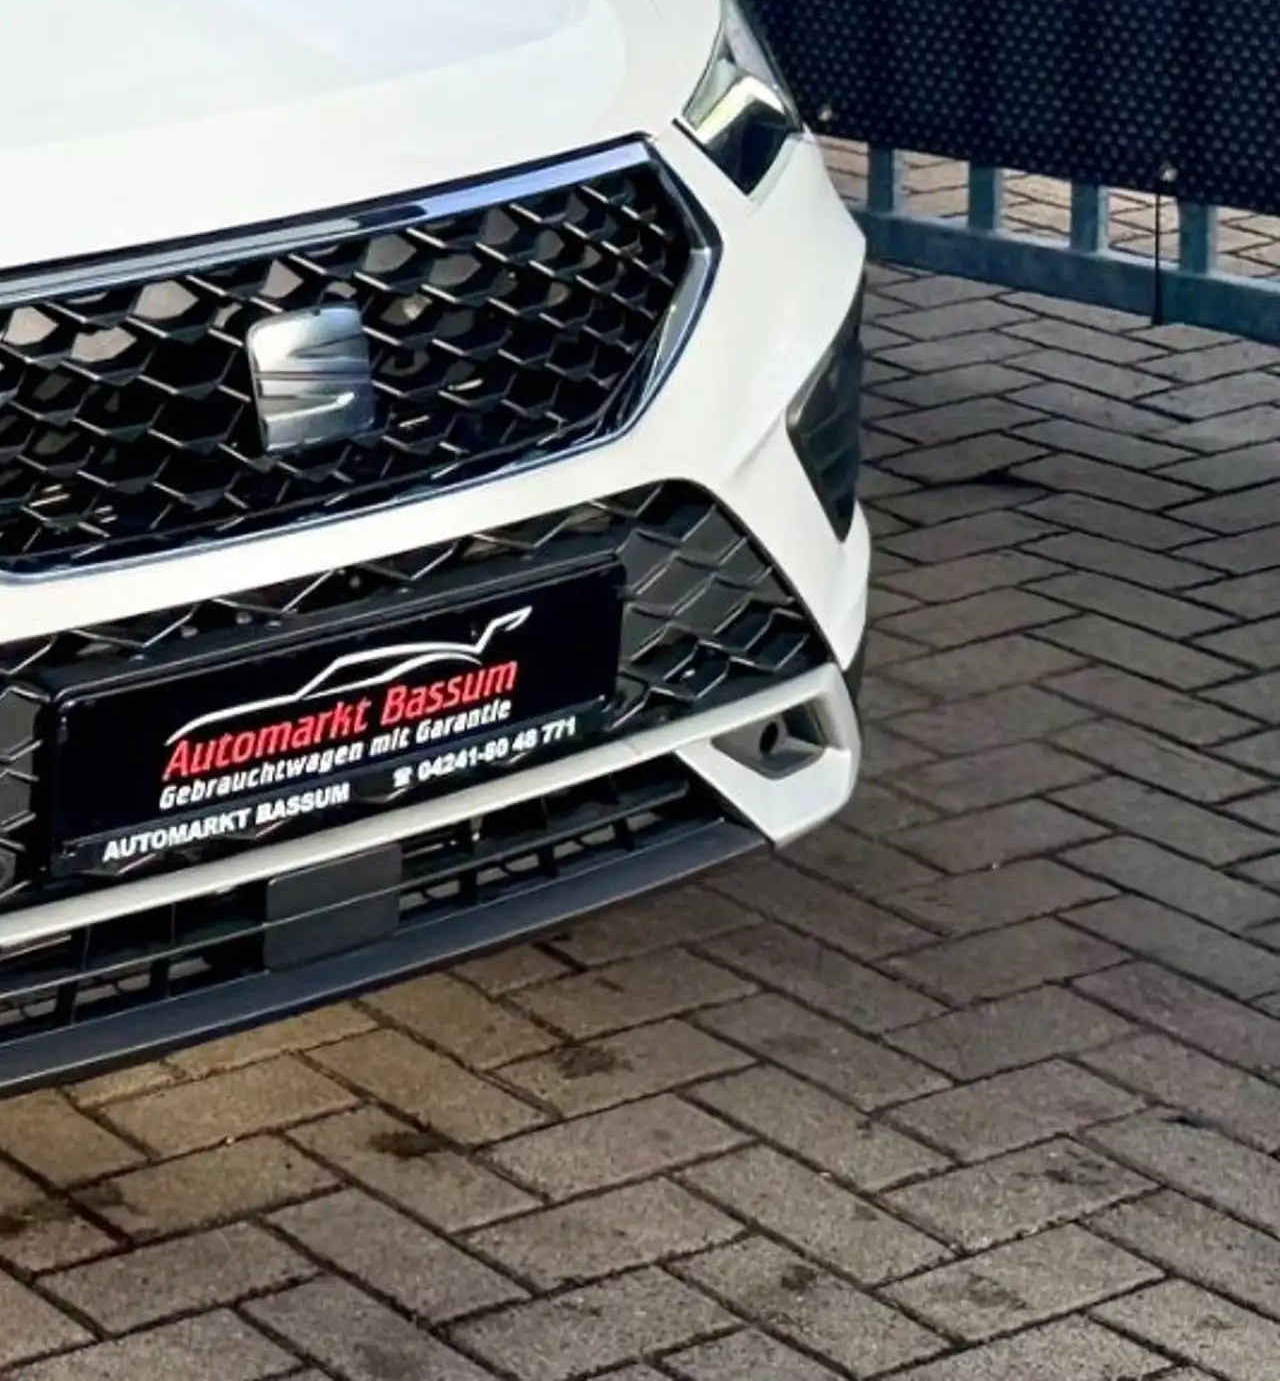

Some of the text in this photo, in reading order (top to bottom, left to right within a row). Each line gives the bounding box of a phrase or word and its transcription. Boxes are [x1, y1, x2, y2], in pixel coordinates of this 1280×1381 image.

[158, 697, 513, 811] Gebrauchtwagen mit Garantie
[162, 659, 519, 782] Automarkt Bassum
[101, 807, 254, 863] AUTOMARKT
[254, 780, 351, 826] BASSUM
[511, 728, 539, 752] 48
[541, 714, 578, 745] 771
